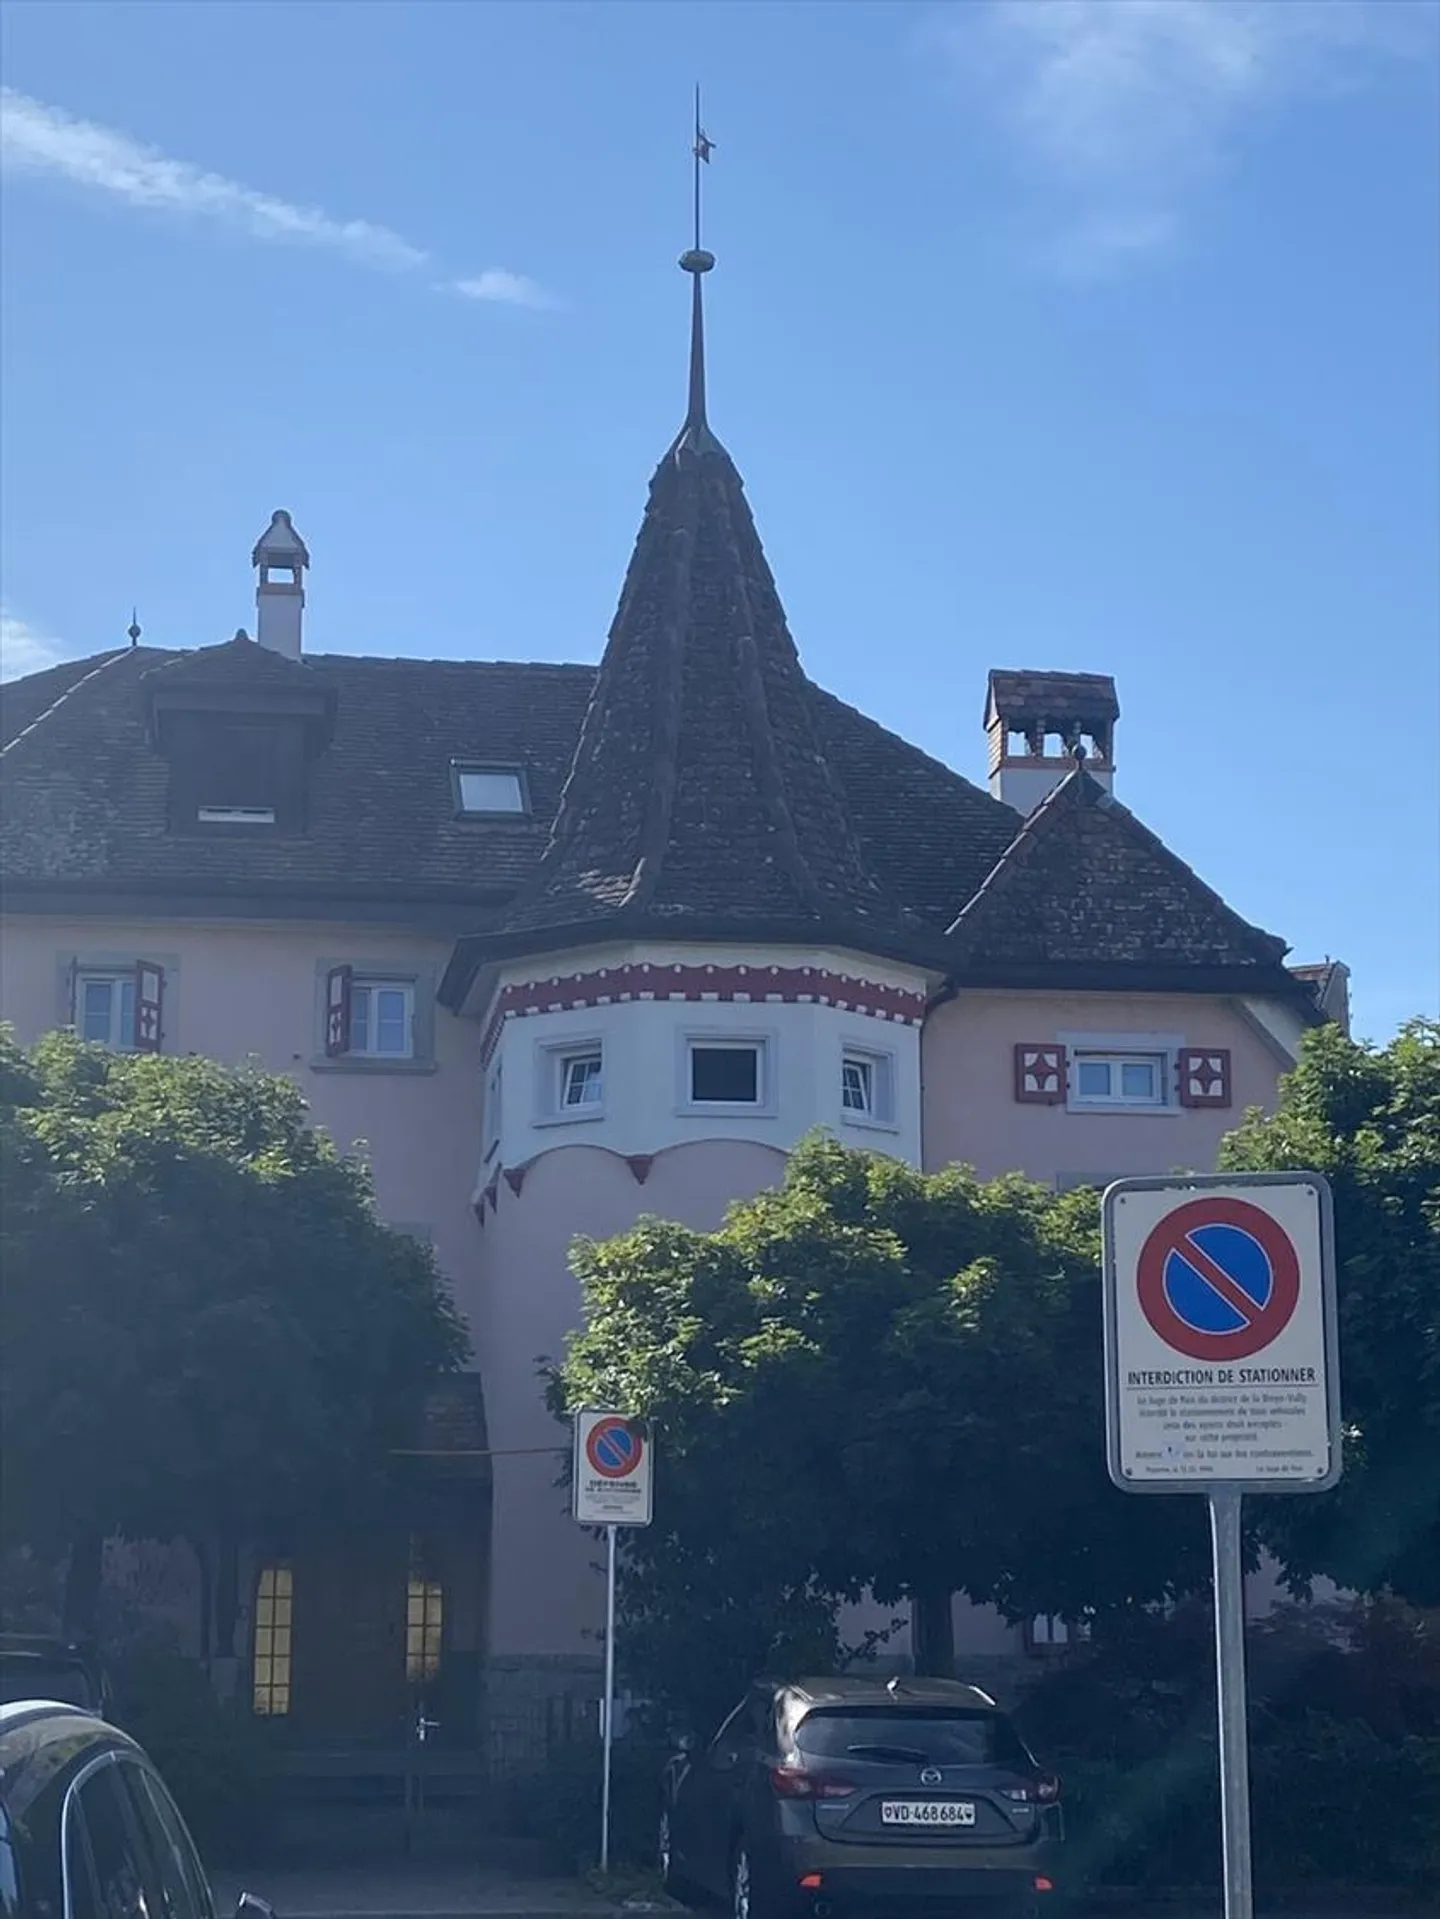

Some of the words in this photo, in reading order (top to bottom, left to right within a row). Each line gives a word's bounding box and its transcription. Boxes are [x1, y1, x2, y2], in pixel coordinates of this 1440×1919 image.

[1128, 1370, 1213, 1385] INTERDICTION
[1218, 1369, 1234, 1383] DE
[1239, 1367, 1316, 1383] STATIONNER
